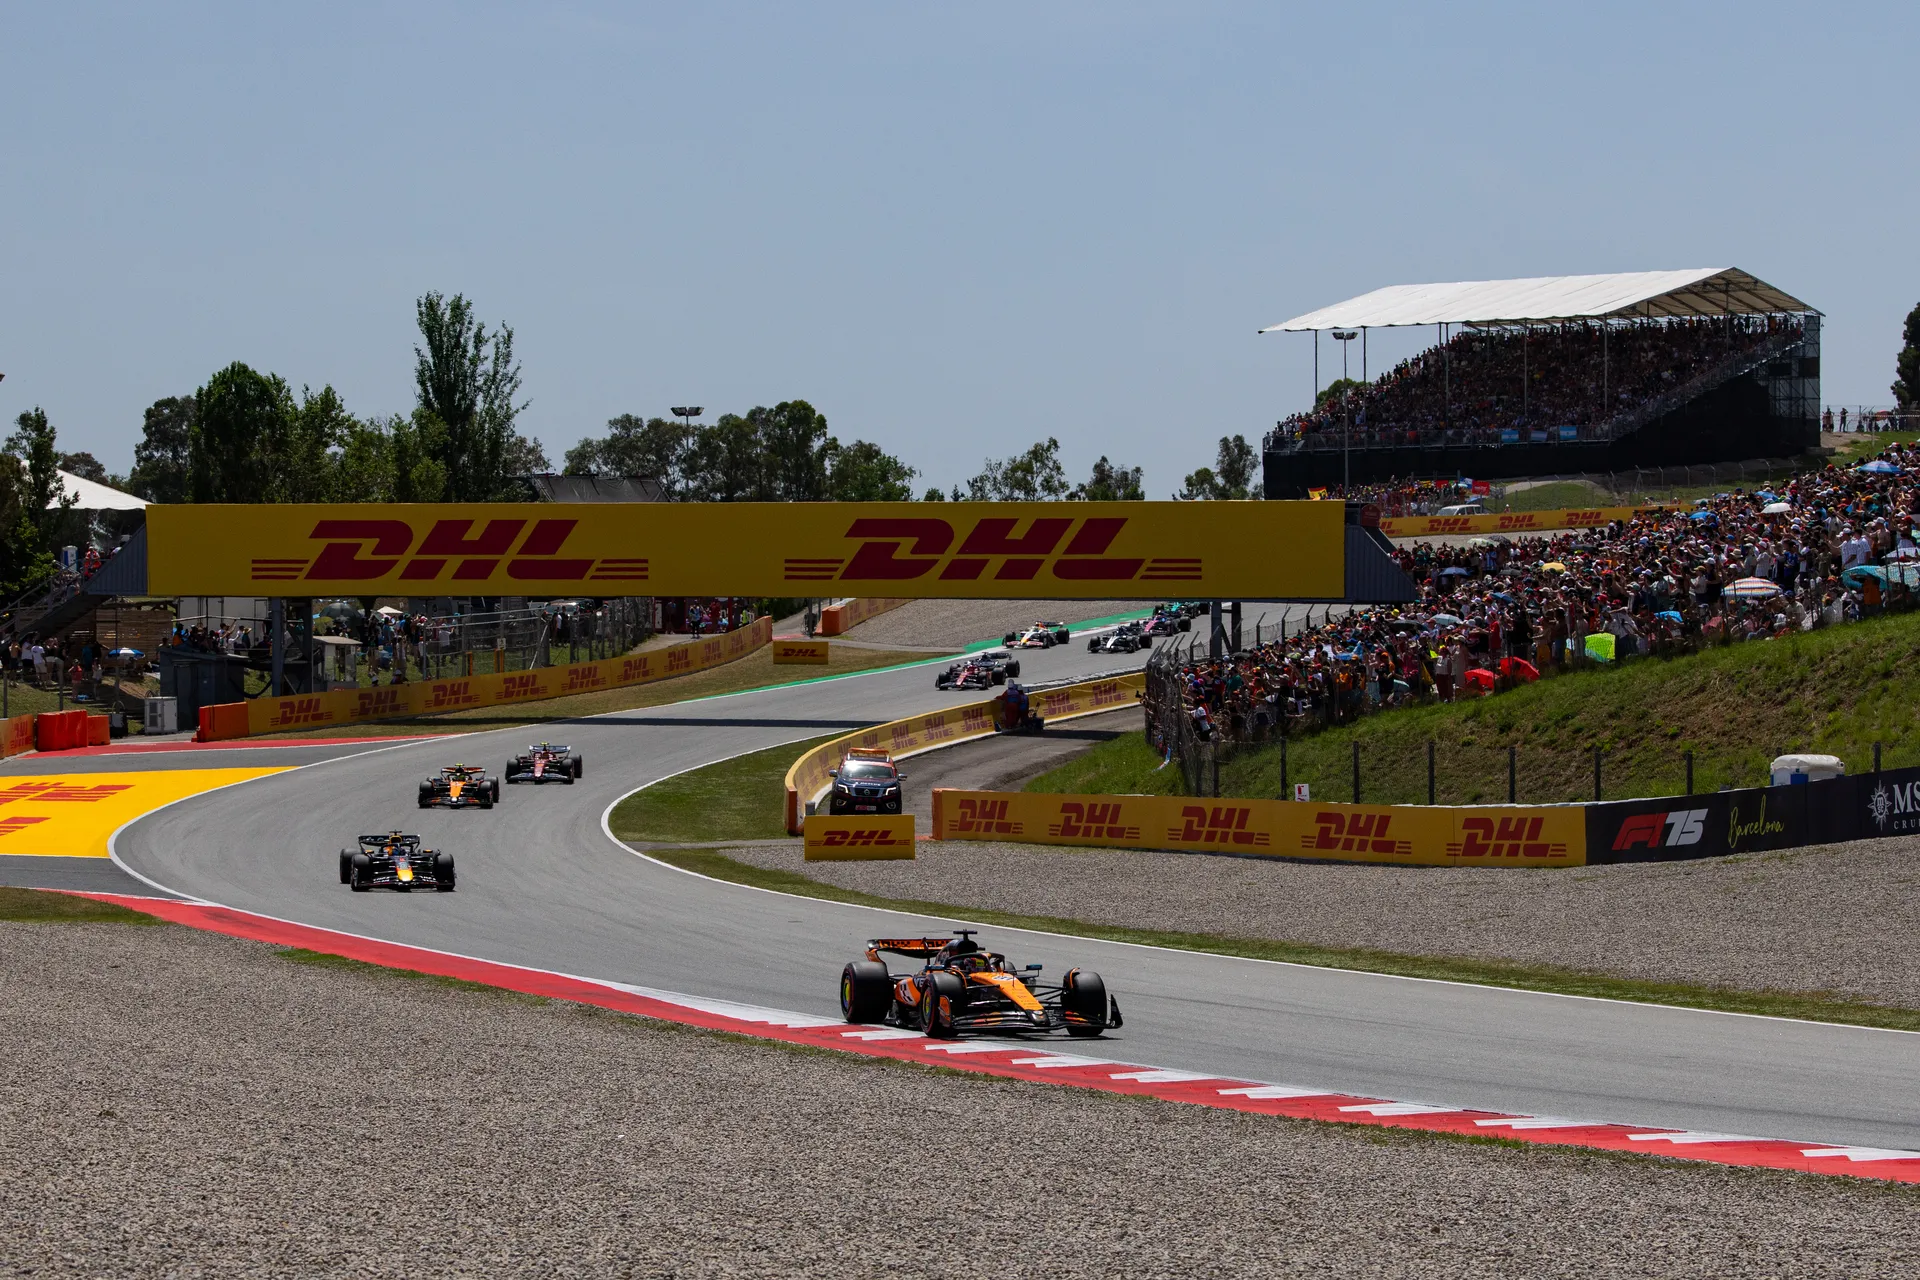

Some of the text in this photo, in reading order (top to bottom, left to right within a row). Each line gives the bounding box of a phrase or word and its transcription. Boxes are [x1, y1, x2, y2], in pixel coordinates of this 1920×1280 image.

[1428, 518, 1473, 533] DHL
[1499, 514, 1536, 529] DHL
[1565, 511, 1604, 526] DHL
[303, 519, 596, 580] DHL
[838, 517, 1146, 580] DHL
[668, 648, 691, 672] DHL
[782, 648, 819, 657] DHL
[568, 666, 600, 690] DHL
[623, 657, 650, 680] DHL
[432, 682, 473, 707] DHL
[503, 674, 540, 698] DHL
[279, 698, 324, 725] DHL
[358, 690, 401, 716] DHL
[962, 707, 988, 731] DHL
[958, 799, 1013, 834] DHL
[1060, 802, 1126, 839] DHL
[1181, 806, 1255, 845] DHL
[1728, 794, 1784, 848] Barcelona
[822, 830, 897, 846] DHL
[1314, 812, 1396, 854] DHL
[1461, 817, 1551, 858] DHL
